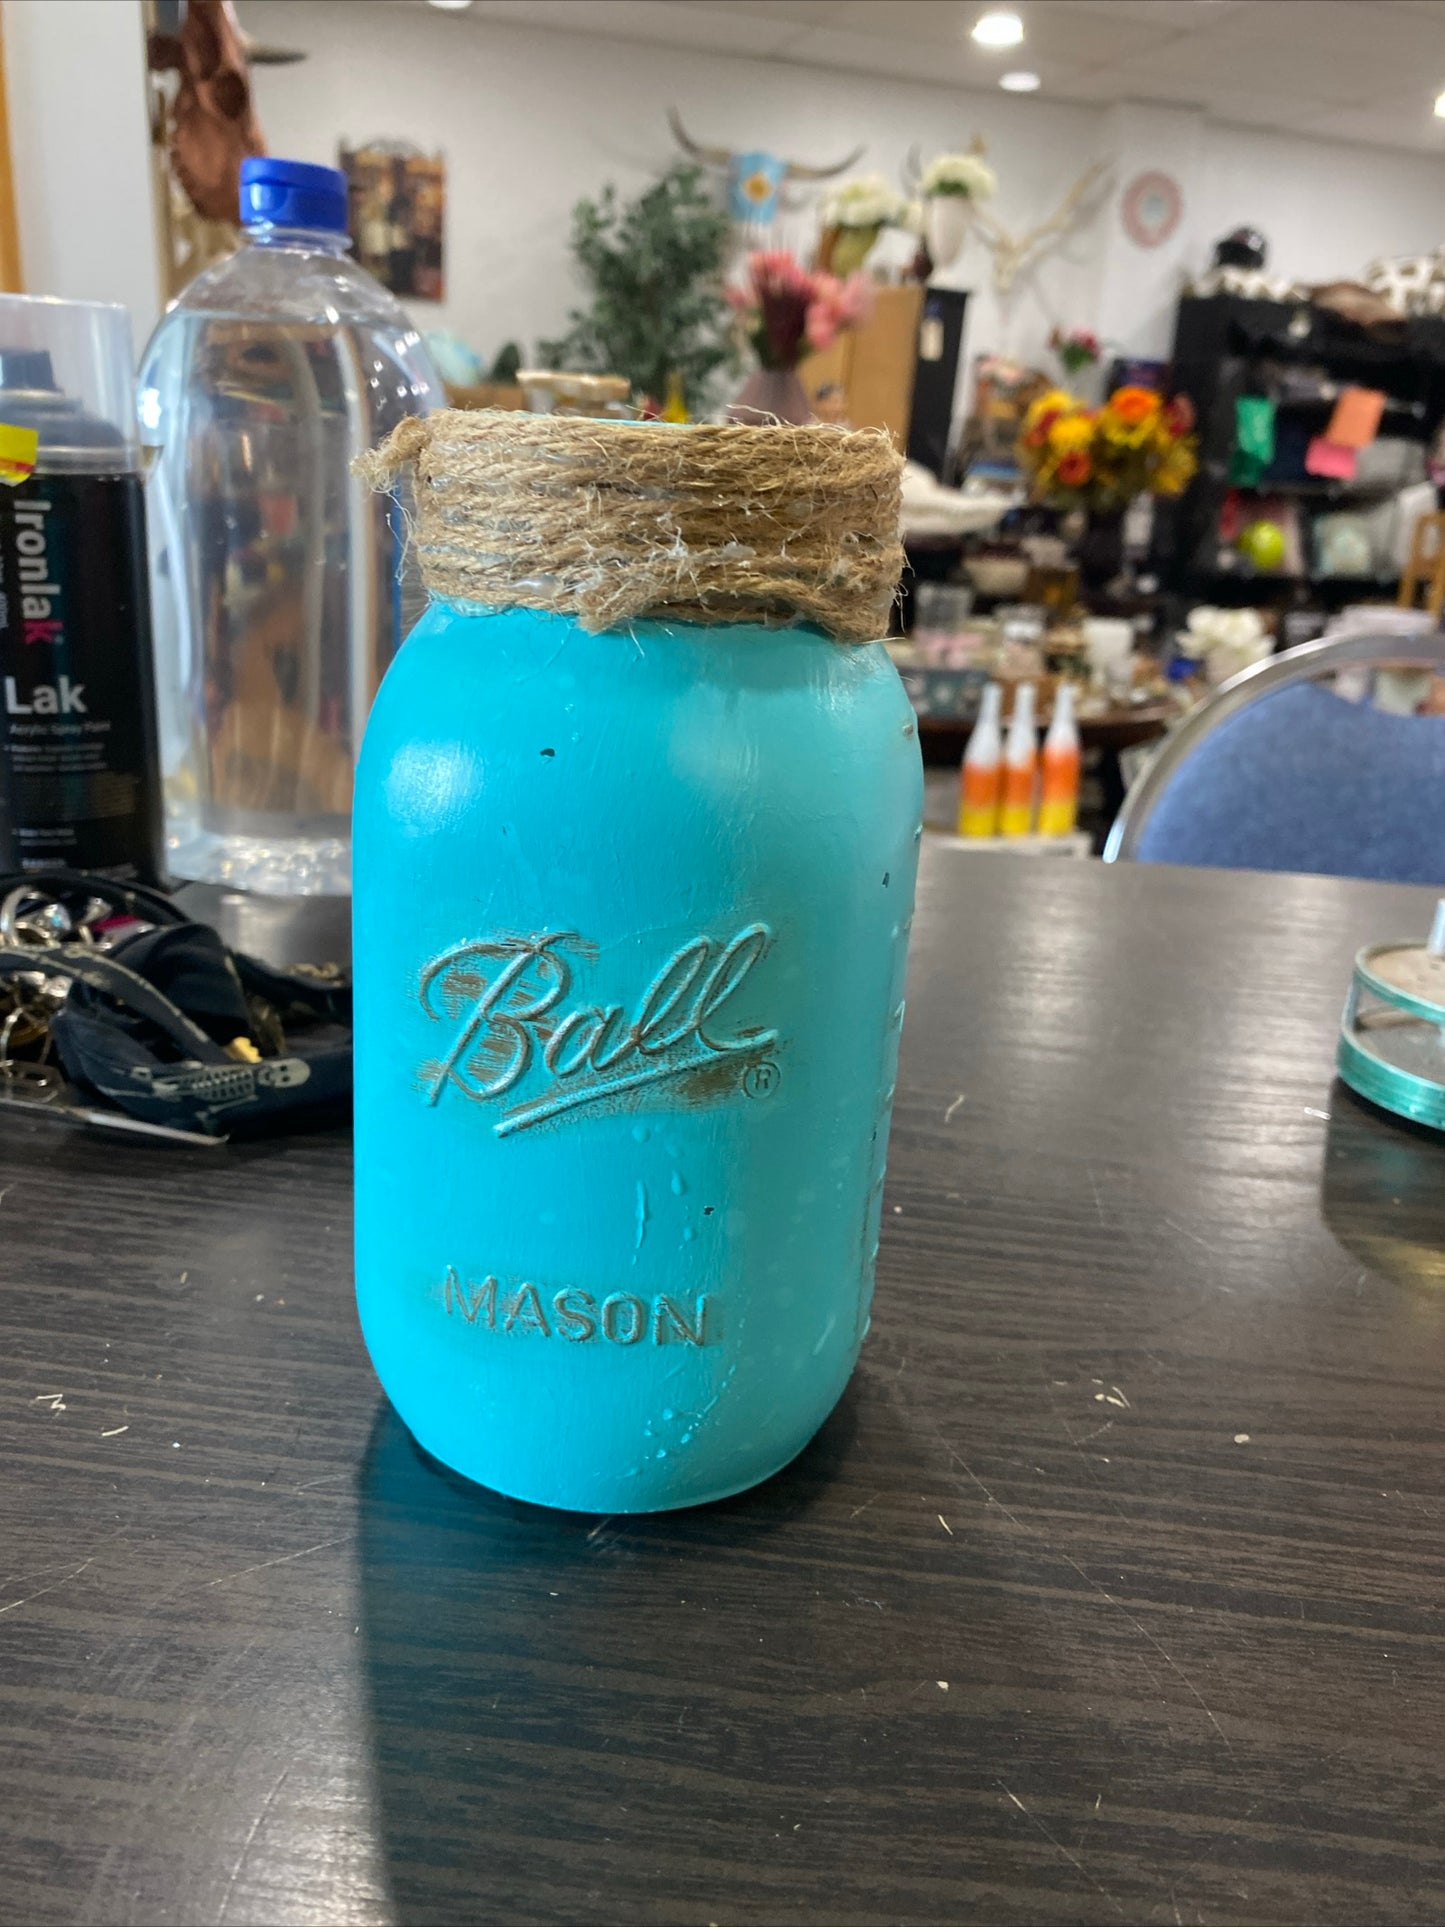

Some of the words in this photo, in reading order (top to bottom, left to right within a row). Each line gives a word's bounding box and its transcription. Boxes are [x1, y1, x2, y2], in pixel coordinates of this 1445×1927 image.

[14, 501, 63, 644] Ironlak
[5, 674, 87, 714] Lak
[417, 921, 779, 1107] Ball
[442, 1264, 710, 1347] MASON
